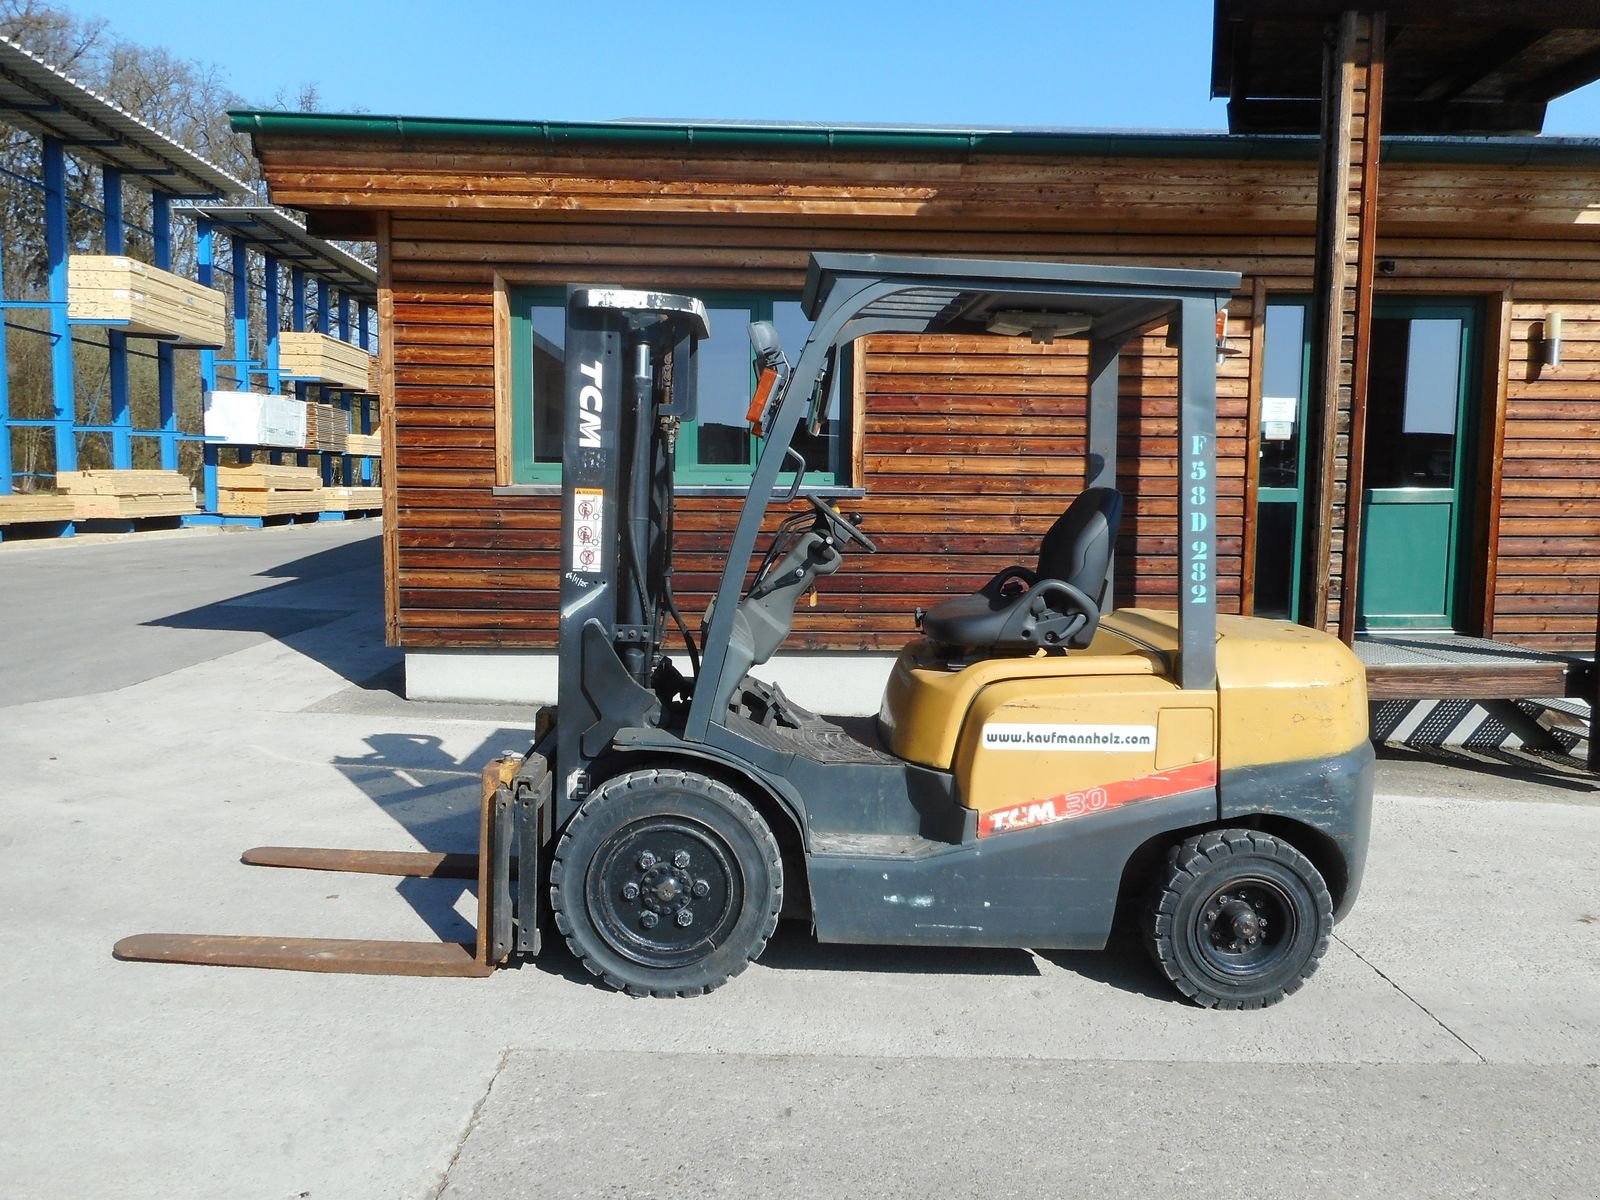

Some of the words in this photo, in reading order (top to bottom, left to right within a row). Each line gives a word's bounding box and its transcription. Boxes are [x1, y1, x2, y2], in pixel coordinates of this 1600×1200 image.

[579, 360, 603, 449] TCM
[986, 731, 1151, 745] www.kaufmannholz.com
[990, 801, 1057, 832] TCM
[1064, 787, 1108, 817] 30
